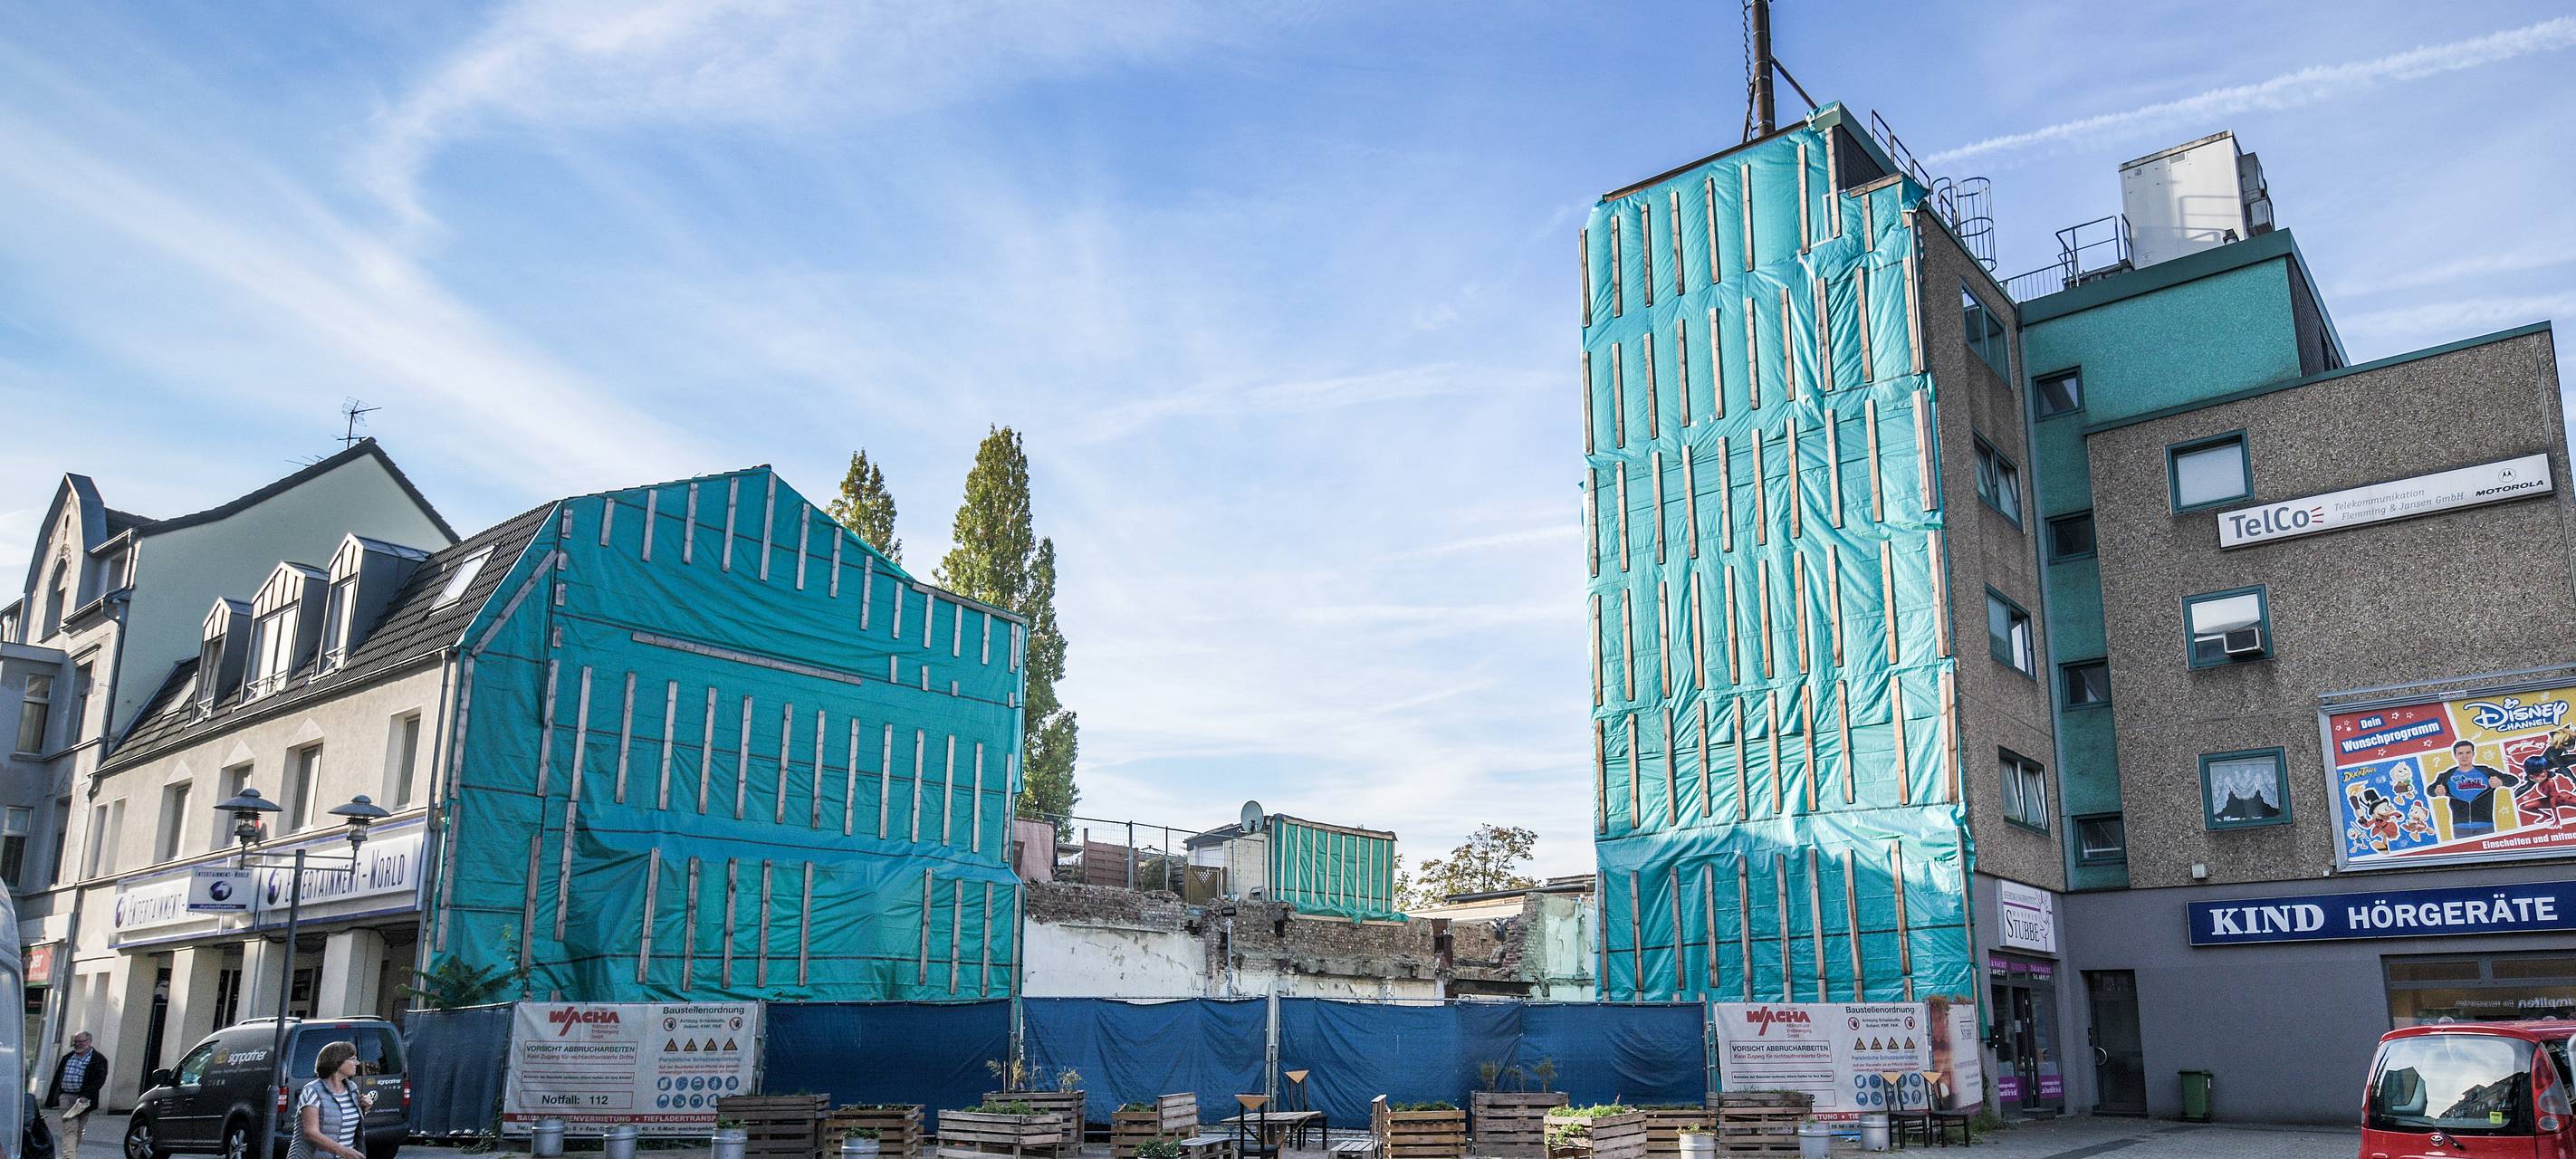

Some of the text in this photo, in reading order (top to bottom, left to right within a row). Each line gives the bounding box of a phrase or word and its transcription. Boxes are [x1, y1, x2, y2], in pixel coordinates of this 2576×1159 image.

[2475, 479, 2544, 497] MOTOROLA
[2334, 489, 2425, 512] Telekommunikation
[2341, 492, 2465, 522] Flemming & Jansen GmbH
[2229, 506, 2310, 539] TelCo
[2360, 716, 2382, 730] Dein
[2497, 717, 2552, 733] CHANNEL
[2341, 721, 2441, 752] Wunschprogramm
[2482, 837, 2532, 850] Einschalten
[2532, 834, 2550, 844] und
[2208, 903, 2326, 936] KIND
[2347, 893, 2559, 930] HÖRGERÄTE
[663, 1006, 745, 1015] Baustellenordnung
[1845, 1006, 1915, 1015] Baustellenordnung
[550, 1007, 620, 1036] WACHA
[1747, 1006, 1812, 1036] WACHA
[227, 1049, 268, 1066] signpartner
[563, 1045, 636, 1053] ABBRUCHARBEITEN
[541, 1094, 608, 1106] Notfall: 112
